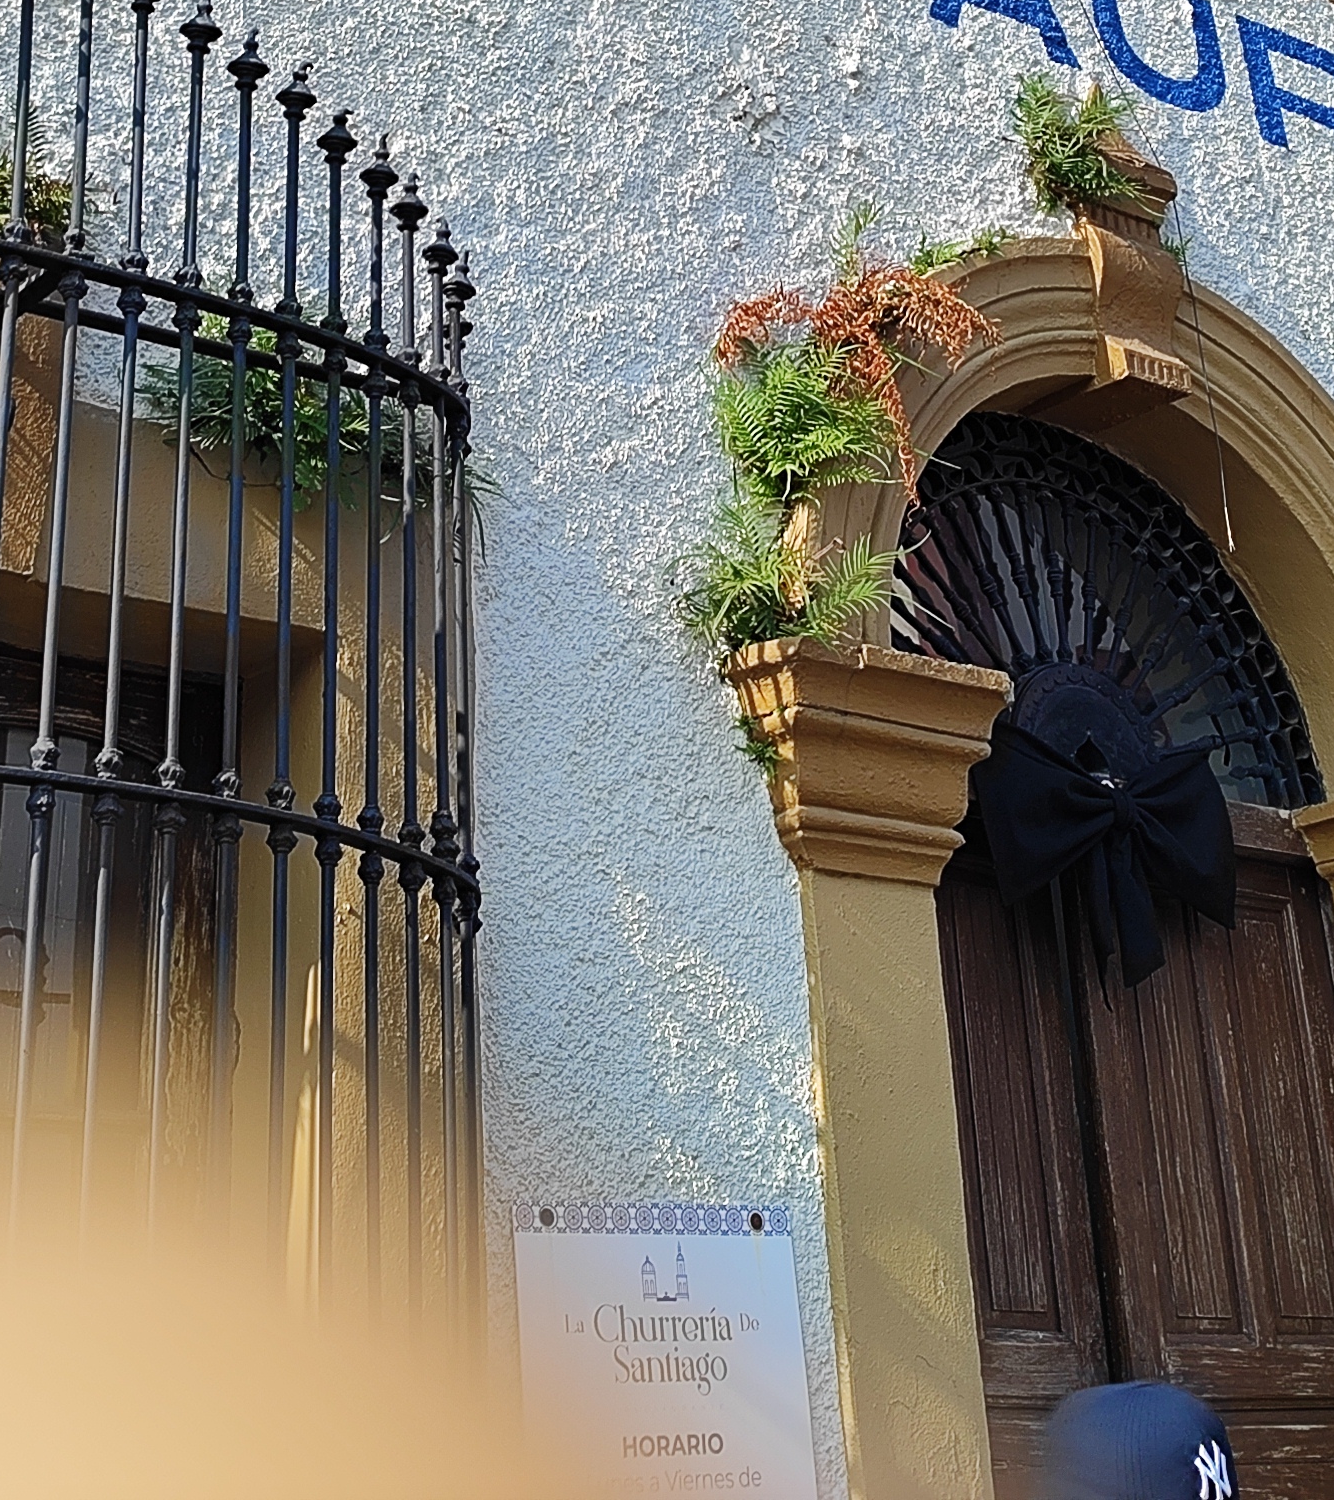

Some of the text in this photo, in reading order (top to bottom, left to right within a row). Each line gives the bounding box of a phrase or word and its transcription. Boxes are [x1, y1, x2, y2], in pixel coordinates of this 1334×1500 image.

[565, 1303, 760, 1344] La Churrería De
[613, 1345, 728, 1396] Santiago
[622, 1432, 724, 1459] HORARIO
[665, 1469, 735, 1492] Viernes
[738, 1466, 762, 1489] de
[1193, 1439, 1232, 1500] NY
